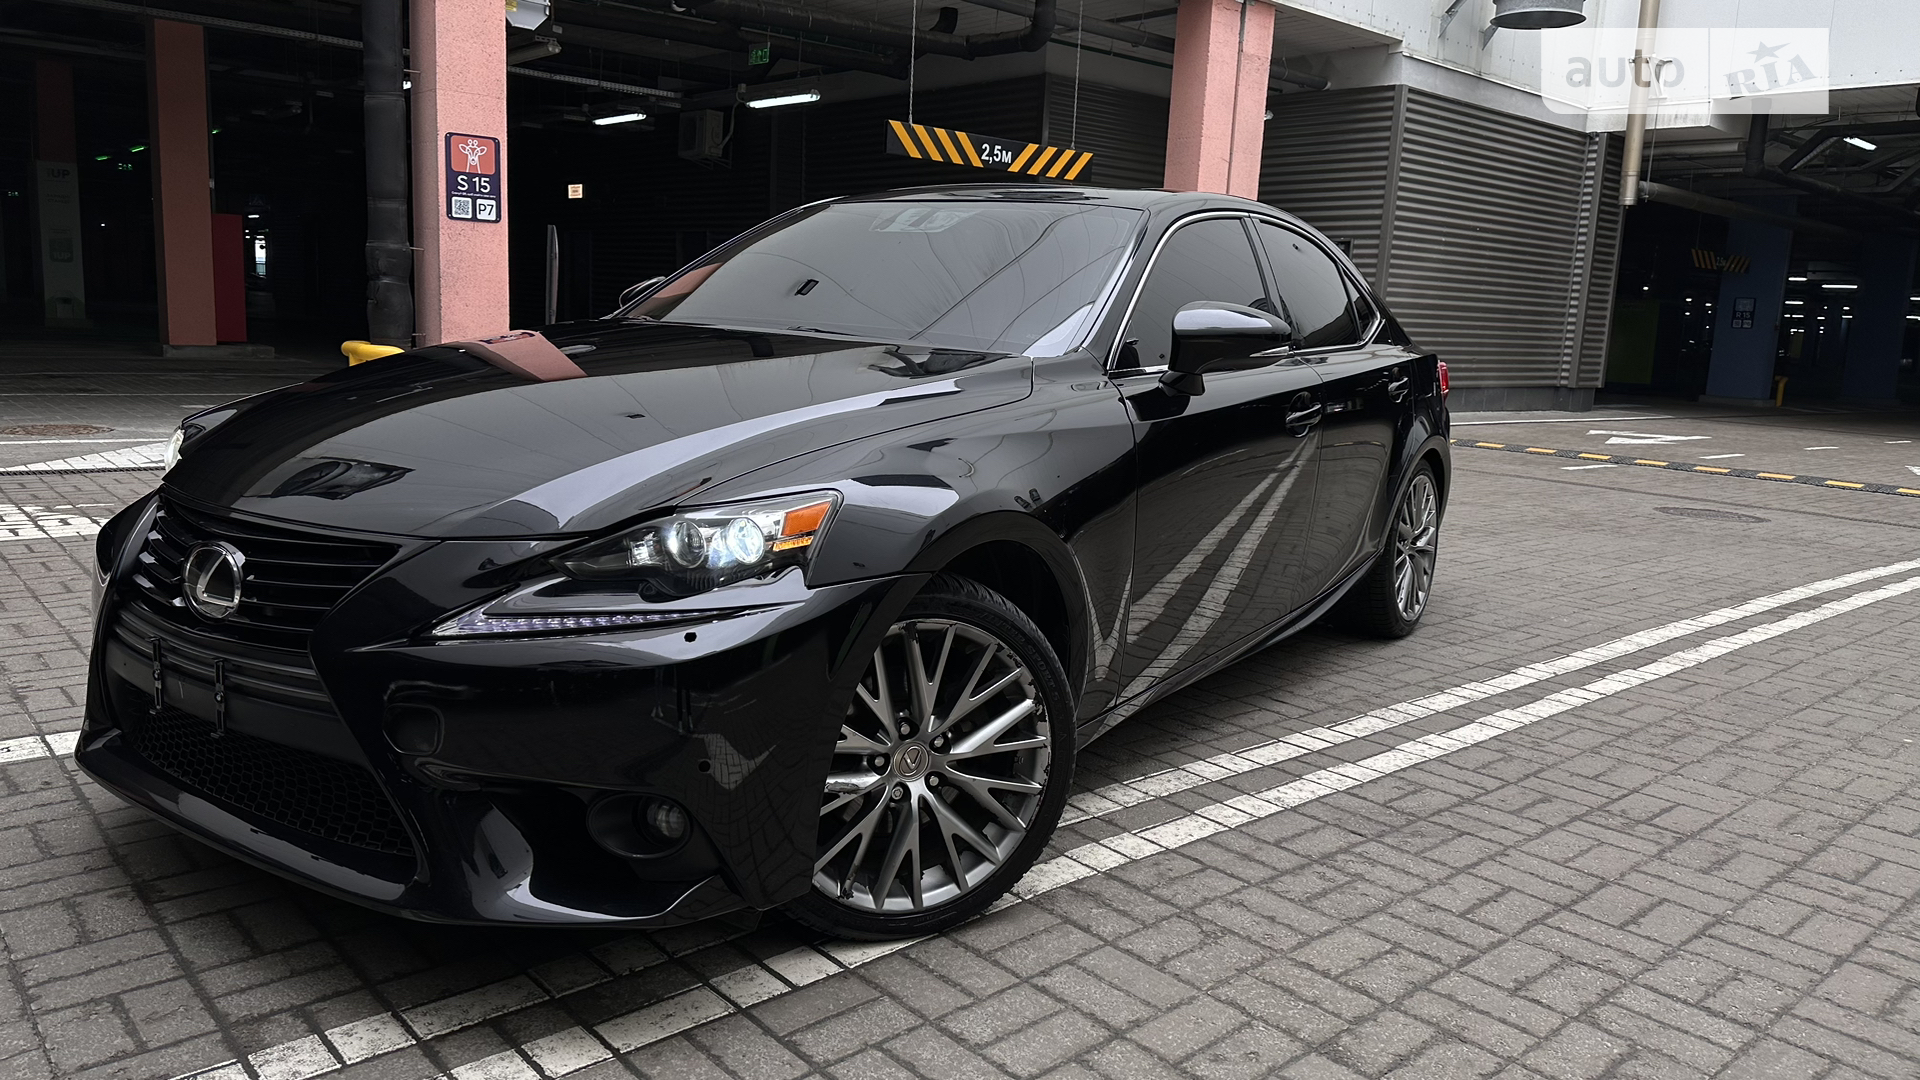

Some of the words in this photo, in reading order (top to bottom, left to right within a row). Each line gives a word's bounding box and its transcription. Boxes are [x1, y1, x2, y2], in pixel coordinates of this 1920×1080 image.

[457, 175, 469, 191] S
[472, 176, 491, 193] 15
[478, 203, 494, 216] P7
